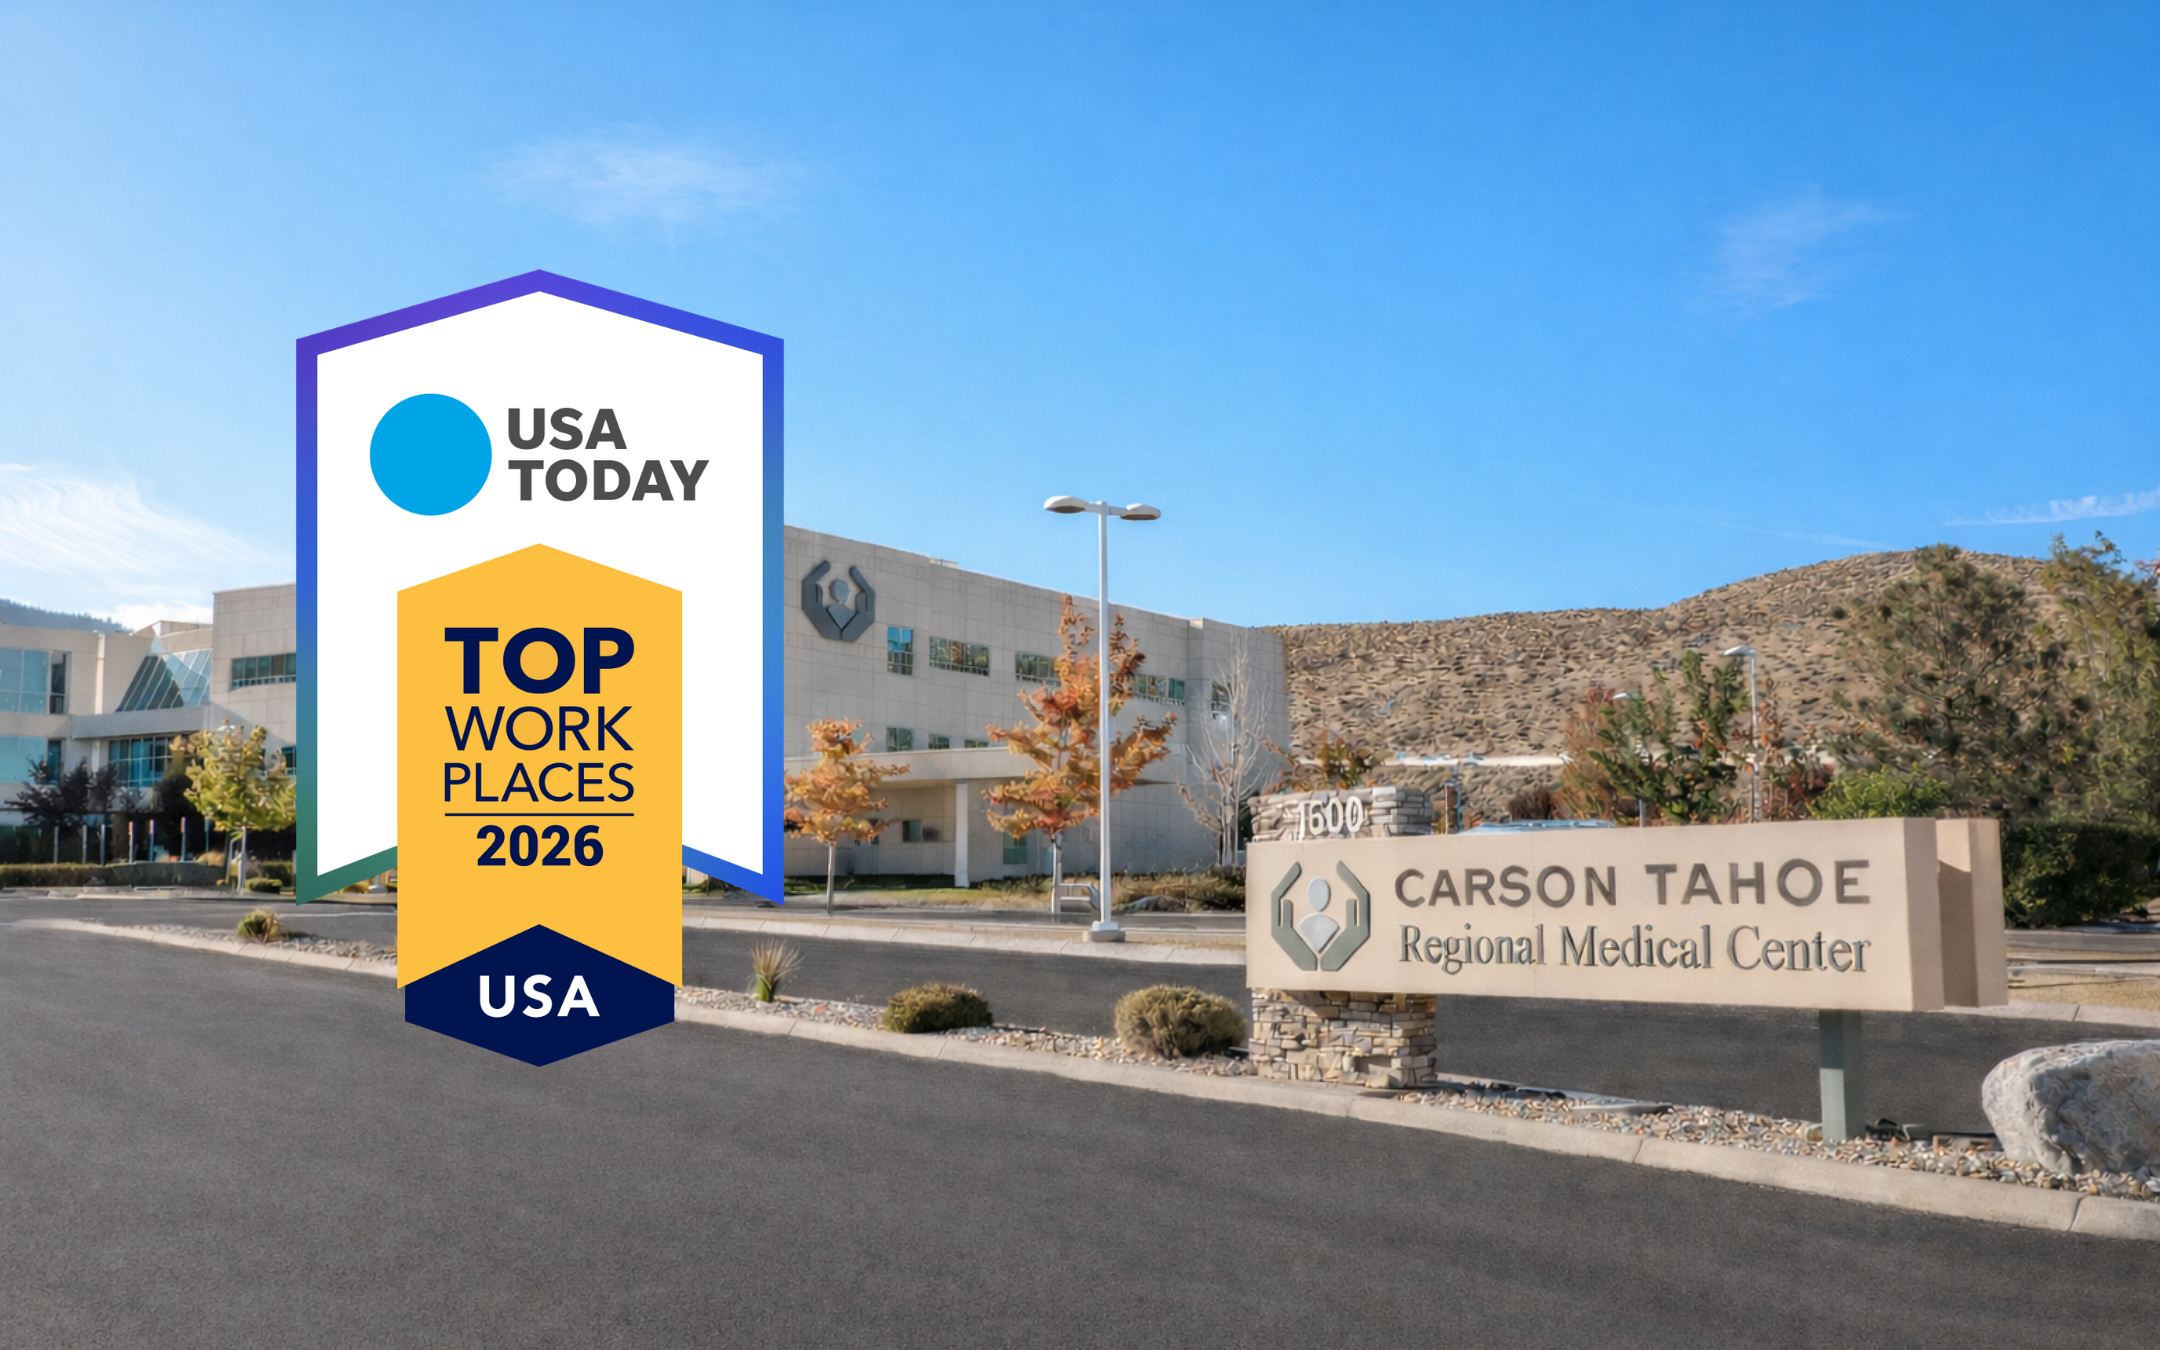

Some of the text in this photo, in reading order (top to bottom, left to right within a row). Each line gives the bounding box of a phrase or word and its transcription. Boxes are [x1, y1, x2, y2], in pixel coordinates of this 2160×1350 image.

[1298, 796, 1364, 840] 1600
[1395, 858, 1870, 908] CARSON TAHOE
[1400, 923, 1872, 976] Regional Medical Center
